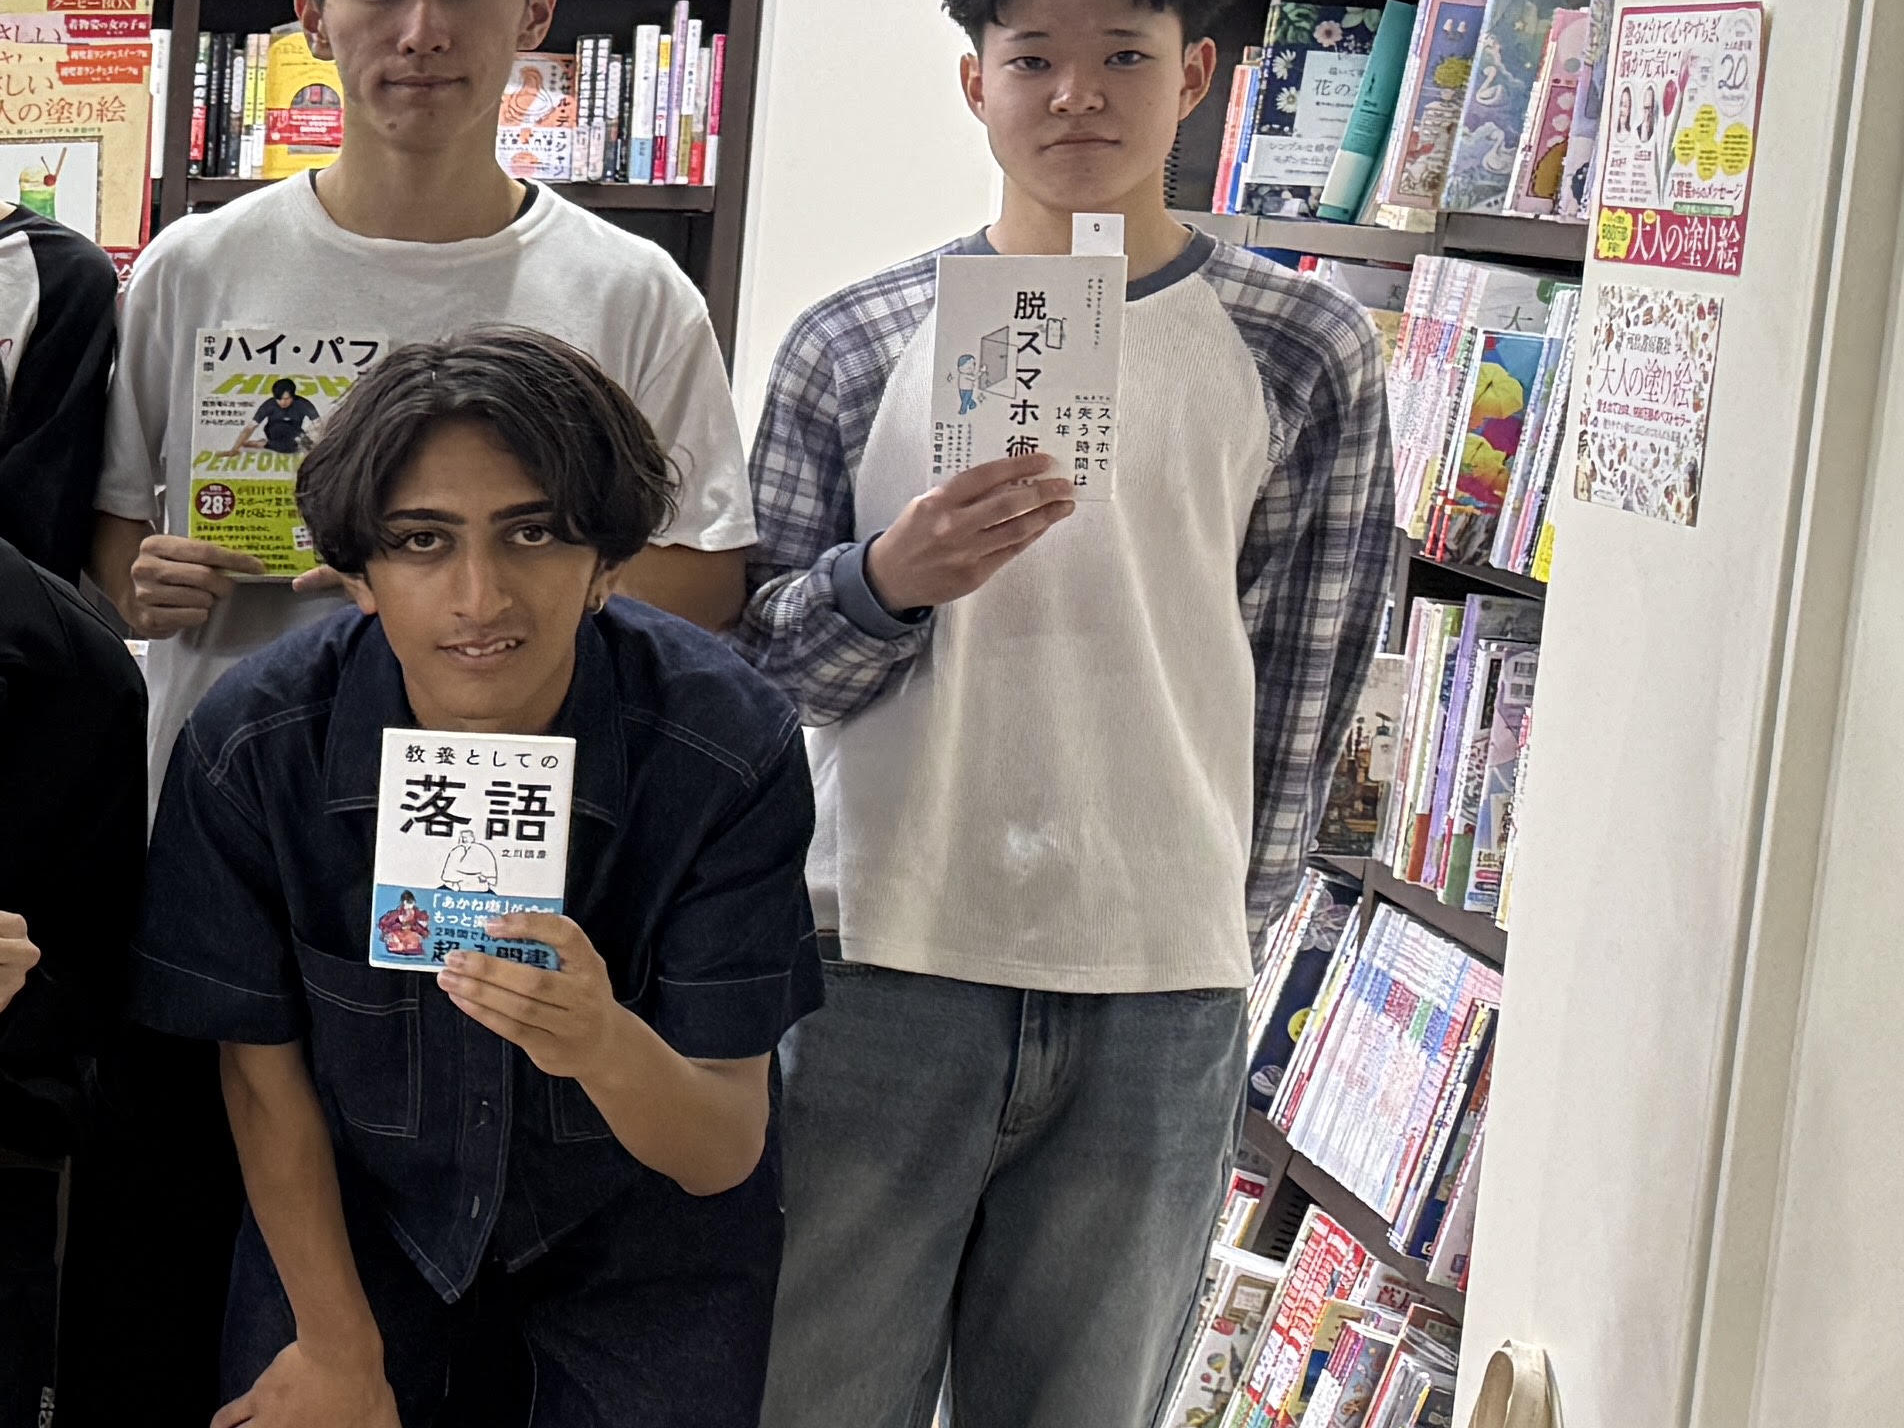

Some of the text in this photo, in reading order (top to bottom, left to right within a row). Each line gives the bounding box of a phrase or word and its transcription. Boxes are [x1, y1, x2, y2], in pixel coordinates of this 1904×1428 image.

[1630, 213, 1739, 270] 大人の塗り絵
[1005, 291, 1047, 458] 脱スマホ術
[1598, 355, 1692, 408] 大人の塗り絵
[1074, 406, 1092, 486] 失う時間は
[1095, 406, 1112, 471] スマホで
[200, 496, 225, 514] 28
[406, 745, 558, 769] 教養としての
[400, 774, 555, 842] 落語
